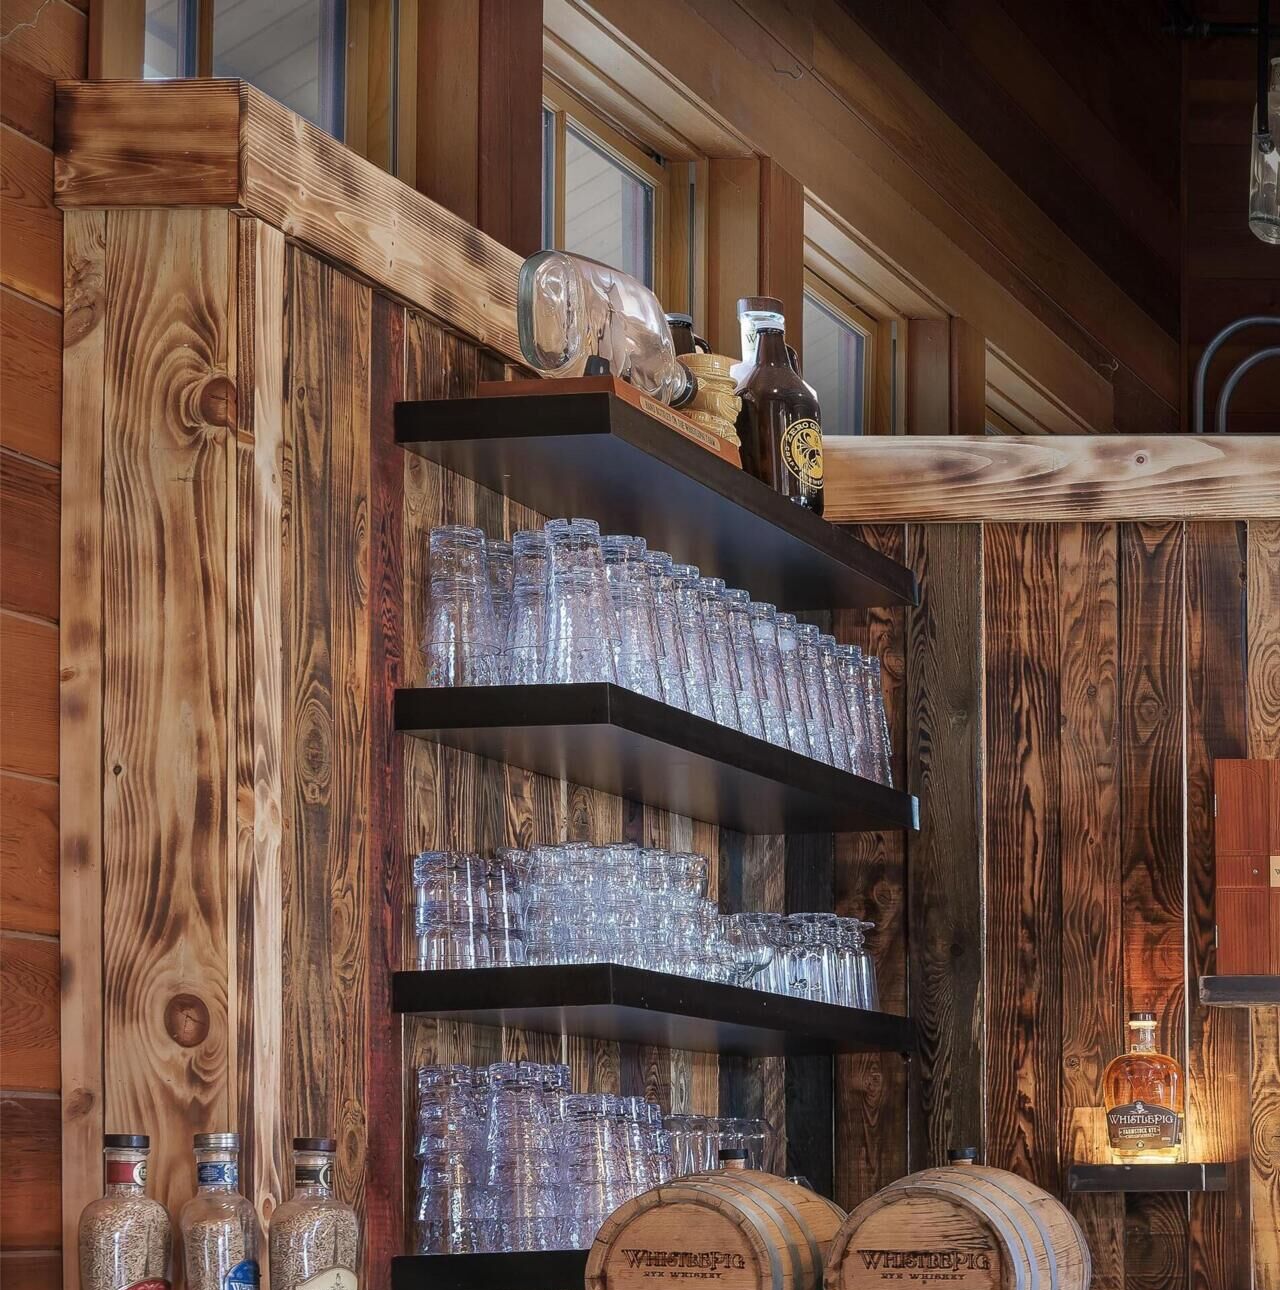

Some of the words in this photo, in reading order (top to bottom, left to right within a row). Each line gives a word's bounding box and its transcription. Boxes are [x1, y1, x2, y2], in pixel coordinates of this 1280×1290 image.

[1108, 1113, 1175, 1125] WHISTLEPIG
[621, 1248, 746, 1272] WHISTLEPIG
[857, 1249, 992, 1272] WHISTLEPIG
[670, 1271, 722, 1279] WHISKEY
